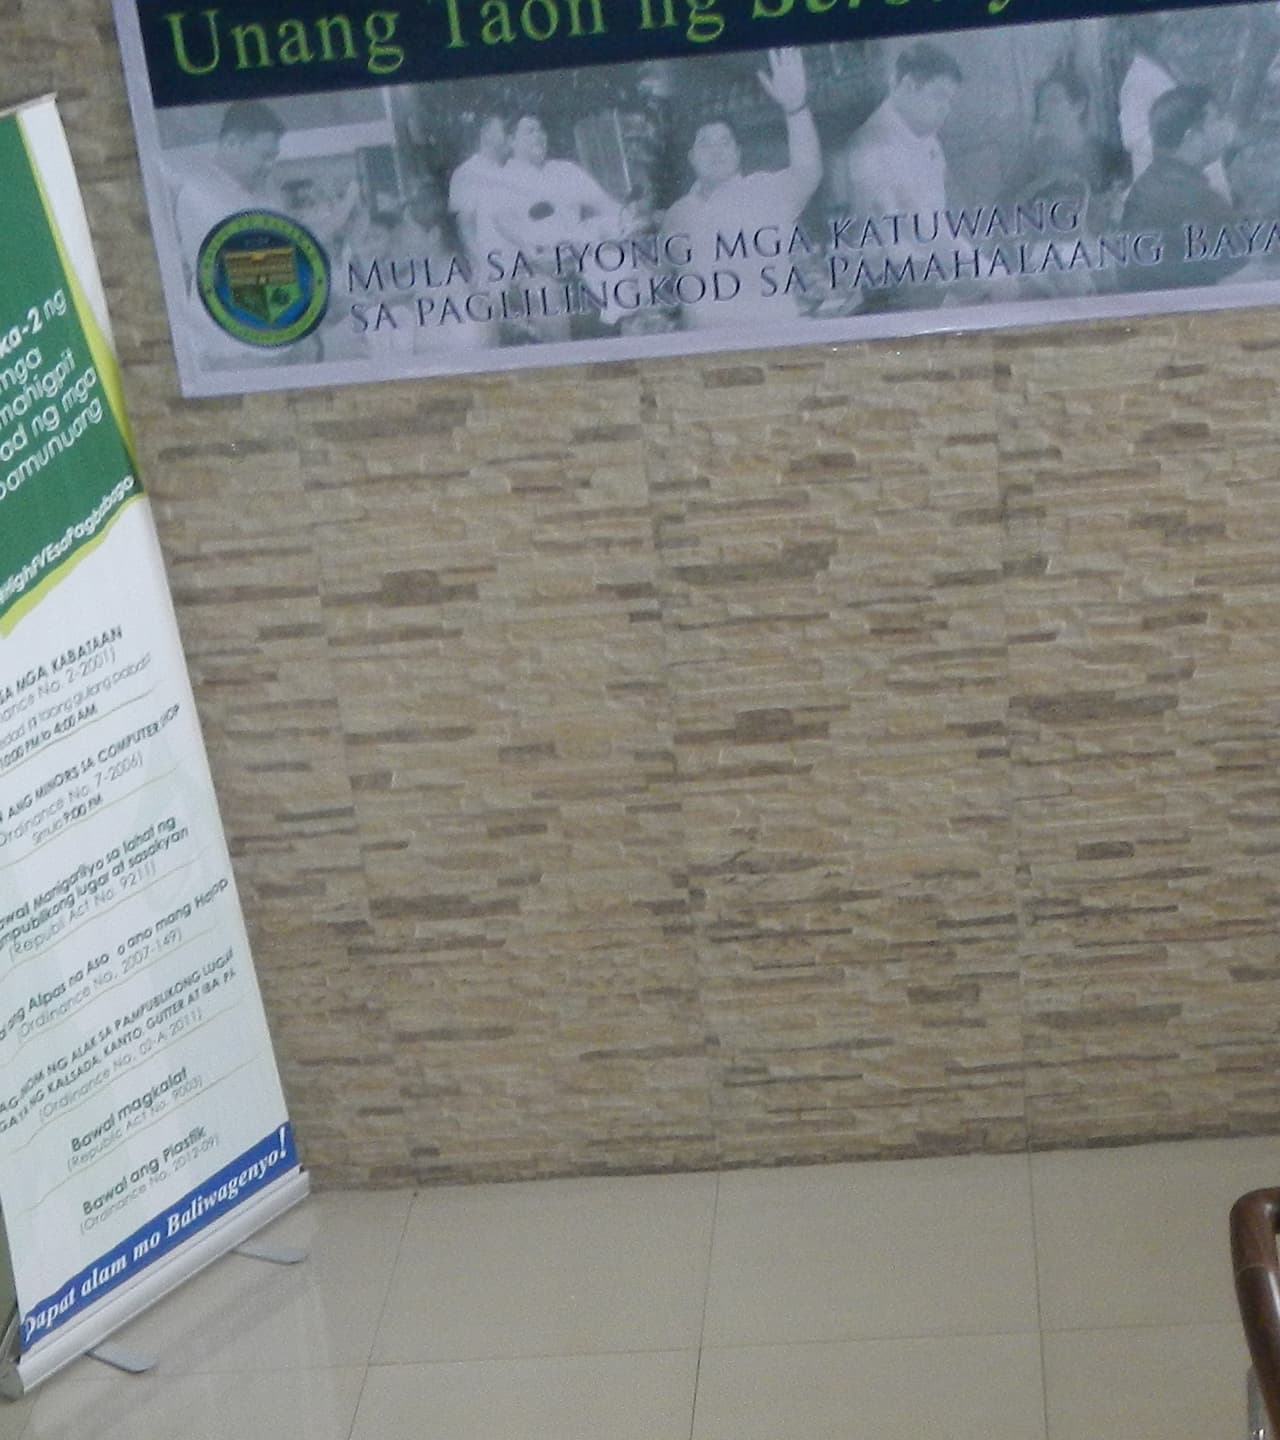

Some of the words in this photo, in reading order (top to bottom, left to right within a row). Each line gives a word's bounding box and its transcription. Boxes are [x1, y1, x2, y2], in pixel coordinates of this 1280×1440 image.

[163, 8, 405, 75] Unang
[347, 254, 472, 293] MULA
[487, 248, 535, 282] SA
[556, 234, 694, 273] IYONG
[714, 224, 813, 260] MGA
[829, 199, 1081, 250] KATUWANG
[43, 291, 67, 320] ng
[351, 299, 398, 334] SA
[418, 270, 742, 328] PAGLILINGKOD
[760, 264, 808, 297] SA
[828, 232, 1166, 289] PAMAHALAANG
[31, 405, 60, 436] ng
[61, 366, 98, 413] mga
[80, 757, 95, 773] SA
[105, 848, 120, 864] sa
[157, 816, 176, 833] ng
[111, 860, 125, 877] at
[68, 969, 84, 987] na
[86, 953, 110, 974] Aso
[127, 928, 153, 948] ano
[155, 903, 192, 932] mang
[186, 988, 200, 1005] AT
[46, 1057, 68, 1076] NG
[97, 1025, 112, 1042] SA
[71, 1113, 115, 1152] Bawal
[117, 1066, 187, 1121] magkalat
[80, 1254, 127, 1297] alam
[133, 1231, 161, 1261] mo
[167, 1126, 286, 1237] Baliwagenyo!
[82, 1175, 127, 1216] Bawal
[130, 1158, 160, 1183] ang
